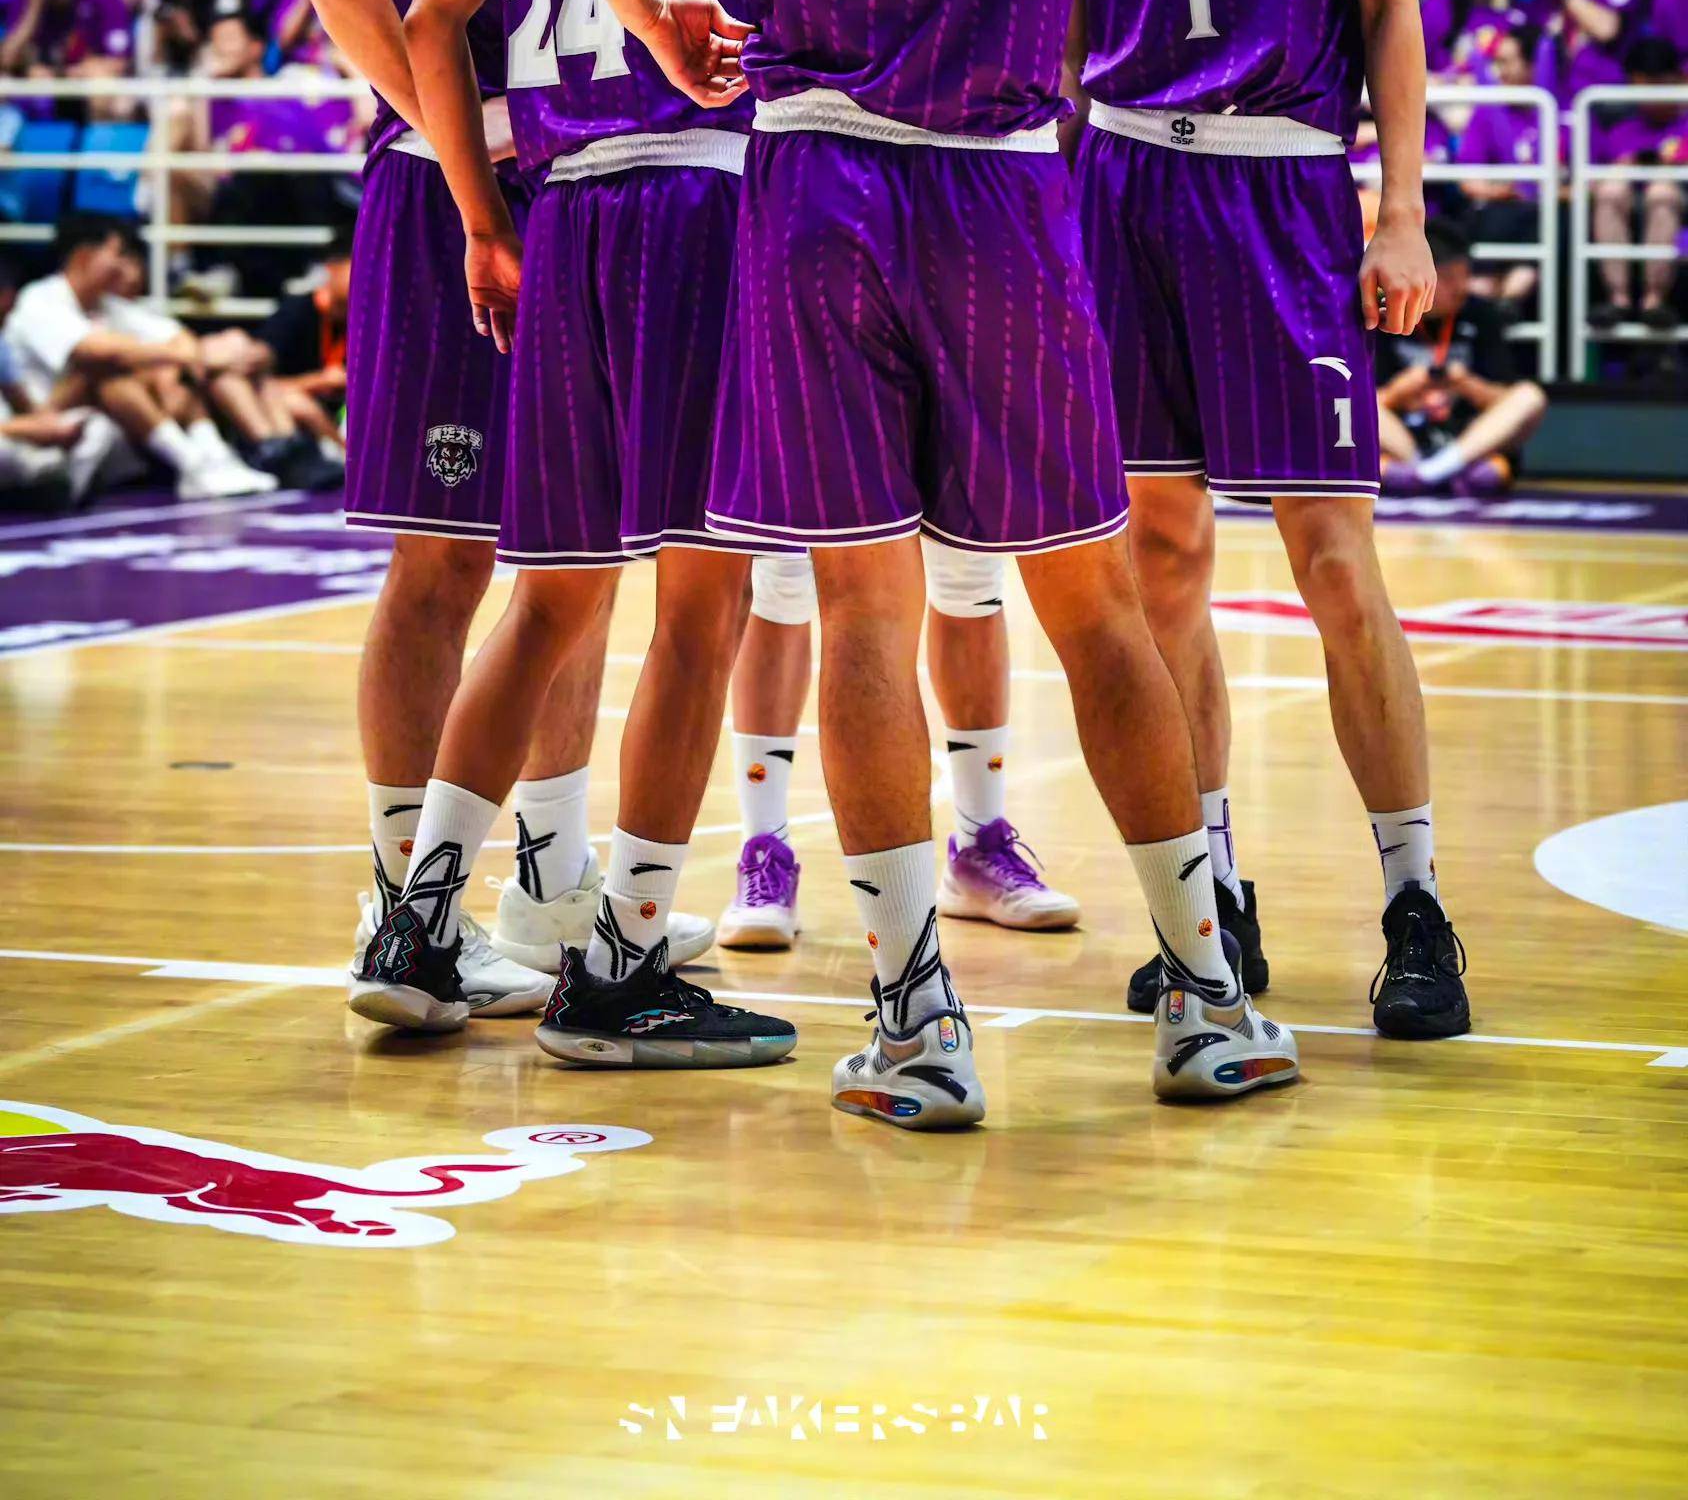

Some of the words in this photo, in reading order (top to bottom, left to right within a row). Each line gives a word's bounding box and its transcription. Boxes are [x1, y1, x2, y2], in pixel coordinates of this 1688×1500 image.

[1170, 136, 1195, 146] CSSF
[1334, 397, 1357, 448] 1
[426, 425, 482, 448] 清华大学
